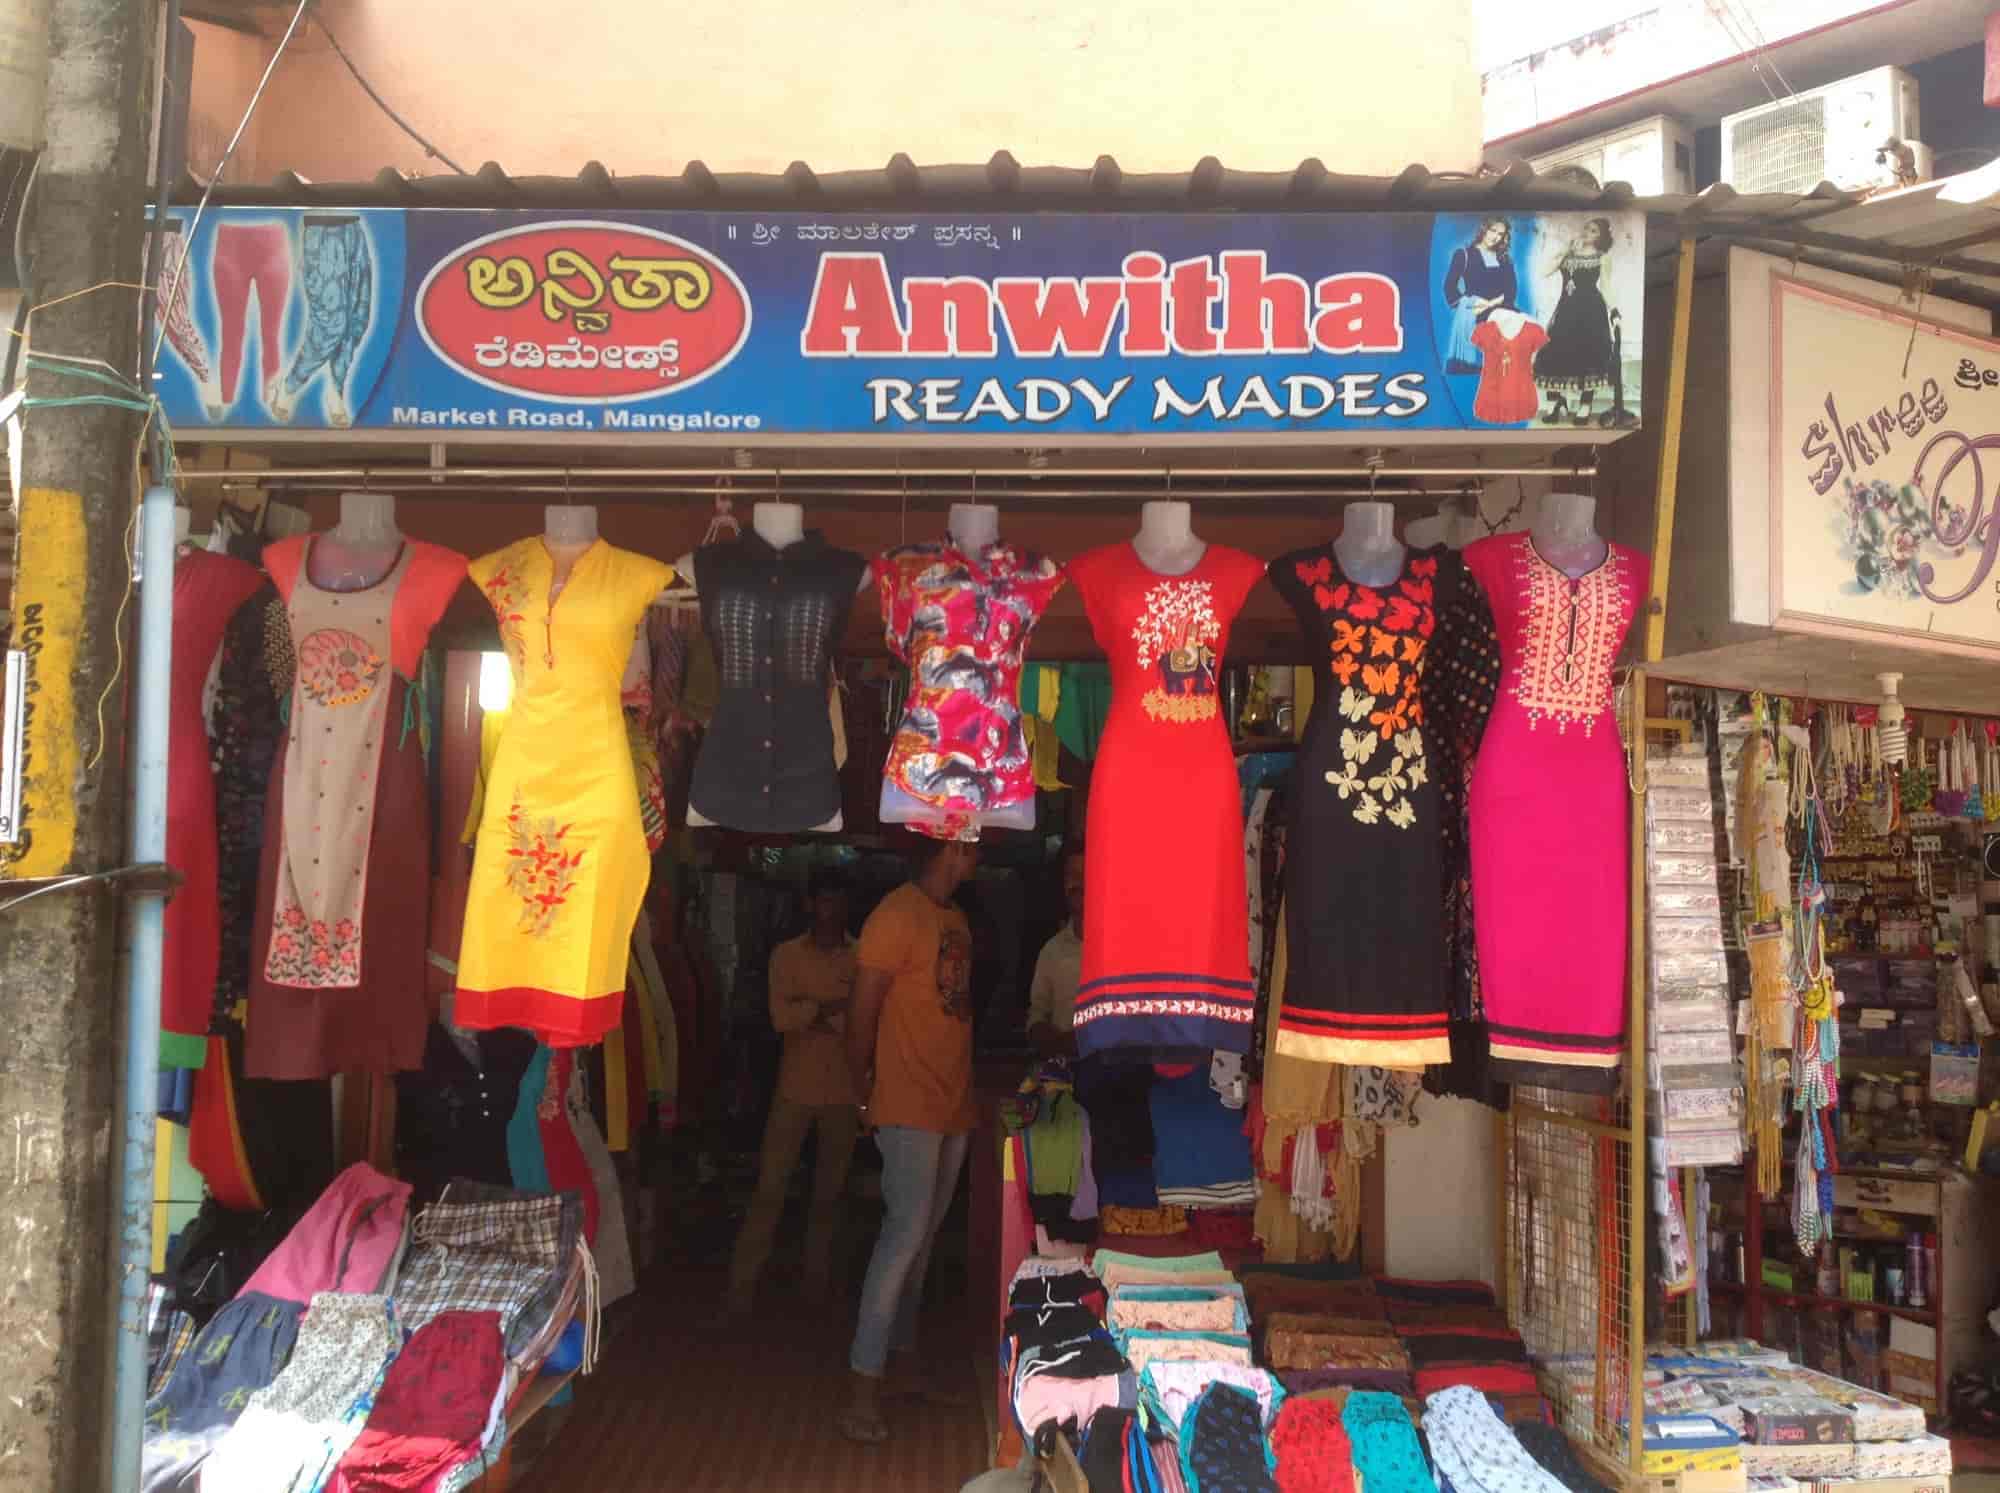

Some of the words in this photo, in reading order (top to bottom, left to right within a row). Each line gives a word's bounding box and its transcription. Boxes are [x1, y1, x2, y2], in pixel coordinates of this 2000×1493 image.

[752, 223, 780, 245] ಶ್ರೀ
[934, 224, 1001, 249] ಪ್ರಸನ್ನ
[467, 248, 711, 333] ಅನ್ವಿತಾ
[800, 250, 1404, 358] Anwitha
[473, 336, 680, 378] ರೆಡಿಮೇಡ್ಸ್
[392, 407, 497, 426] Market
[507, 409, 593, 429] Road,
[603, 410, 761, 431] Mangalore
[865, 375, 1132, 424] READY
[1152, 373, 1429, 422] MADES
[1801, 377, 1948, 496] Shree
